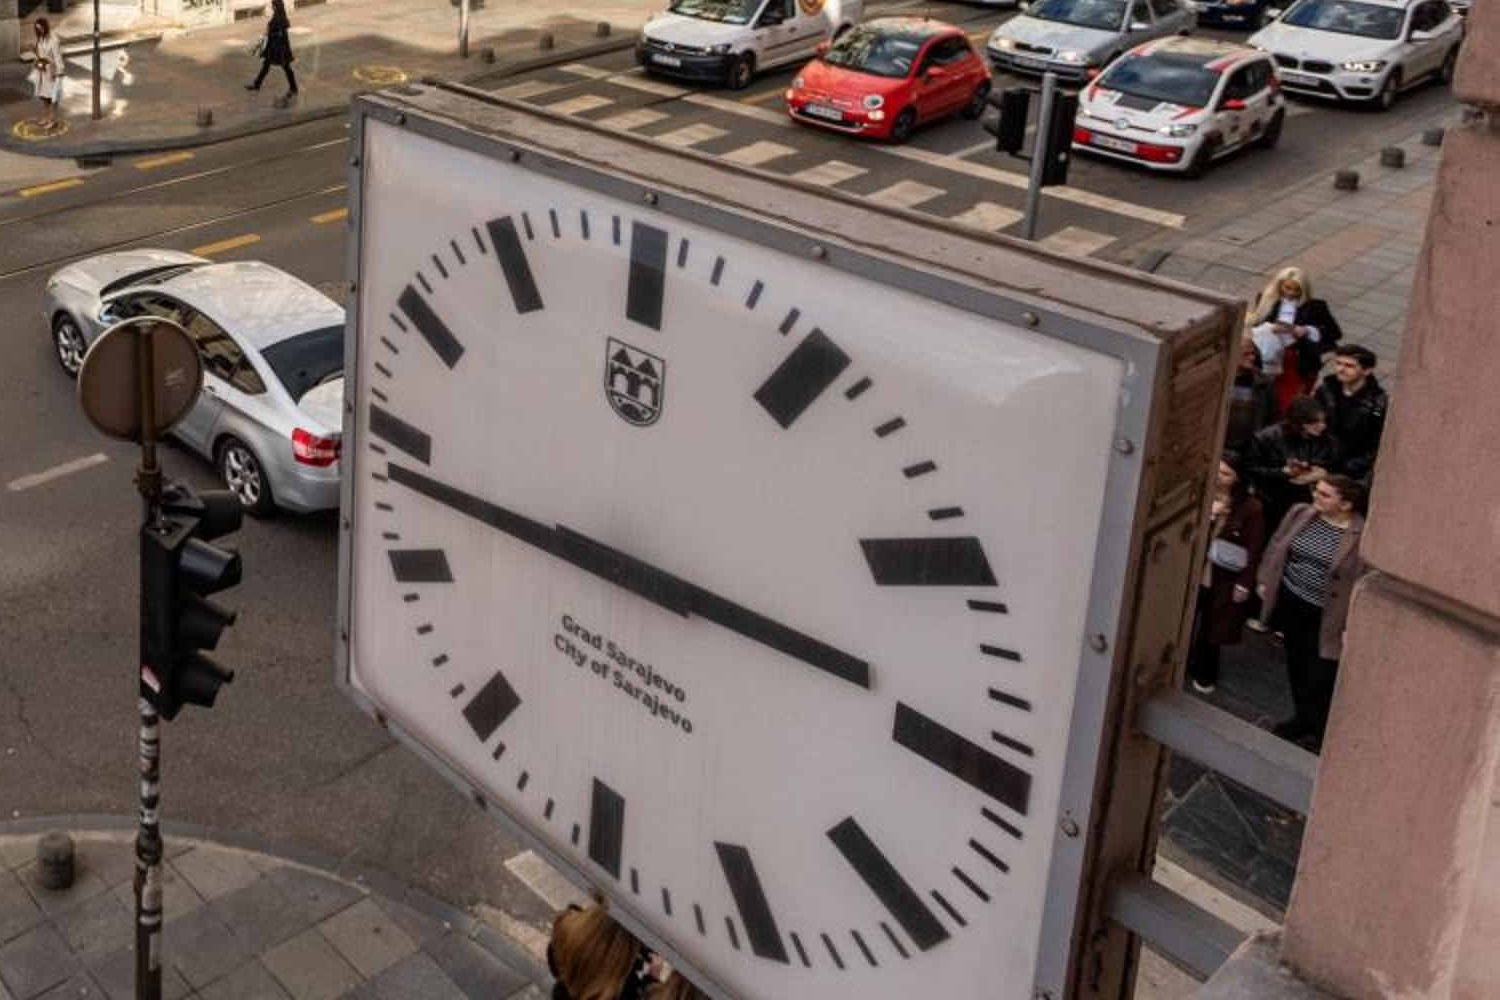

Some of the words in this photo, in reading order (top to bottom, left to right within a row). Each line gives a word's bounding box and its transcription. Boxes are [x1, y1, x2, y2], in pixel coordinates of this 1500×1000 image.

[553, 633, 588, 667] City
[590, 660, 611, 680] of
[612, 670, 693, 734] Sarajevo
[561, 614, 603, 651] Grad
[605, 641, 687, 703] Sarajevo
